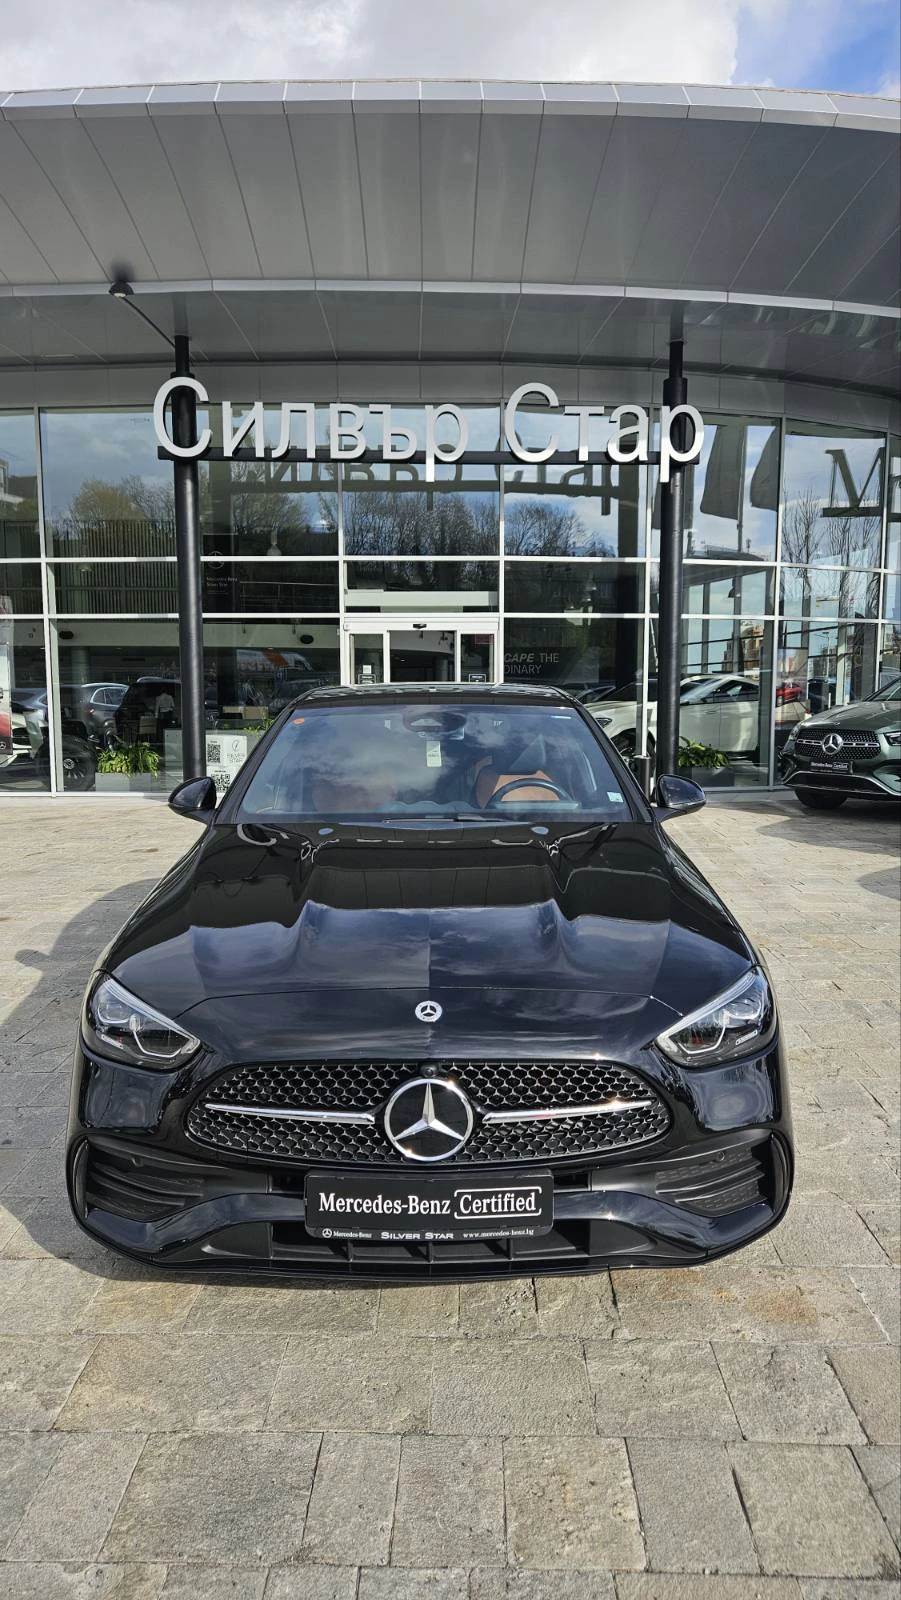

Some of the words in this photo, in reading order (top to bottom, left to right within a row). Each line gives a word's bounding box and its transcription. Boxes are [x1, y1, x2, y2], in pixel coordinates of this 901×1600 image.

[153, 376, 469, 483] Силвър
[503, 382, 705, 483] Стар
[504, 652, 535, 663] CAPE
[539, 652, 560, 663] THE
[504, 664, 542, 674] DINARY
[318, 1192, 451, 1215] Mercedes-Benz
[459, 1191, 536, 1214] Certified
[333, 1230, 372, 1239] Mercedes-Benz
[381, 1231, 421, 1240] SILVER
[424, 1231, 454, 1240] STAR
